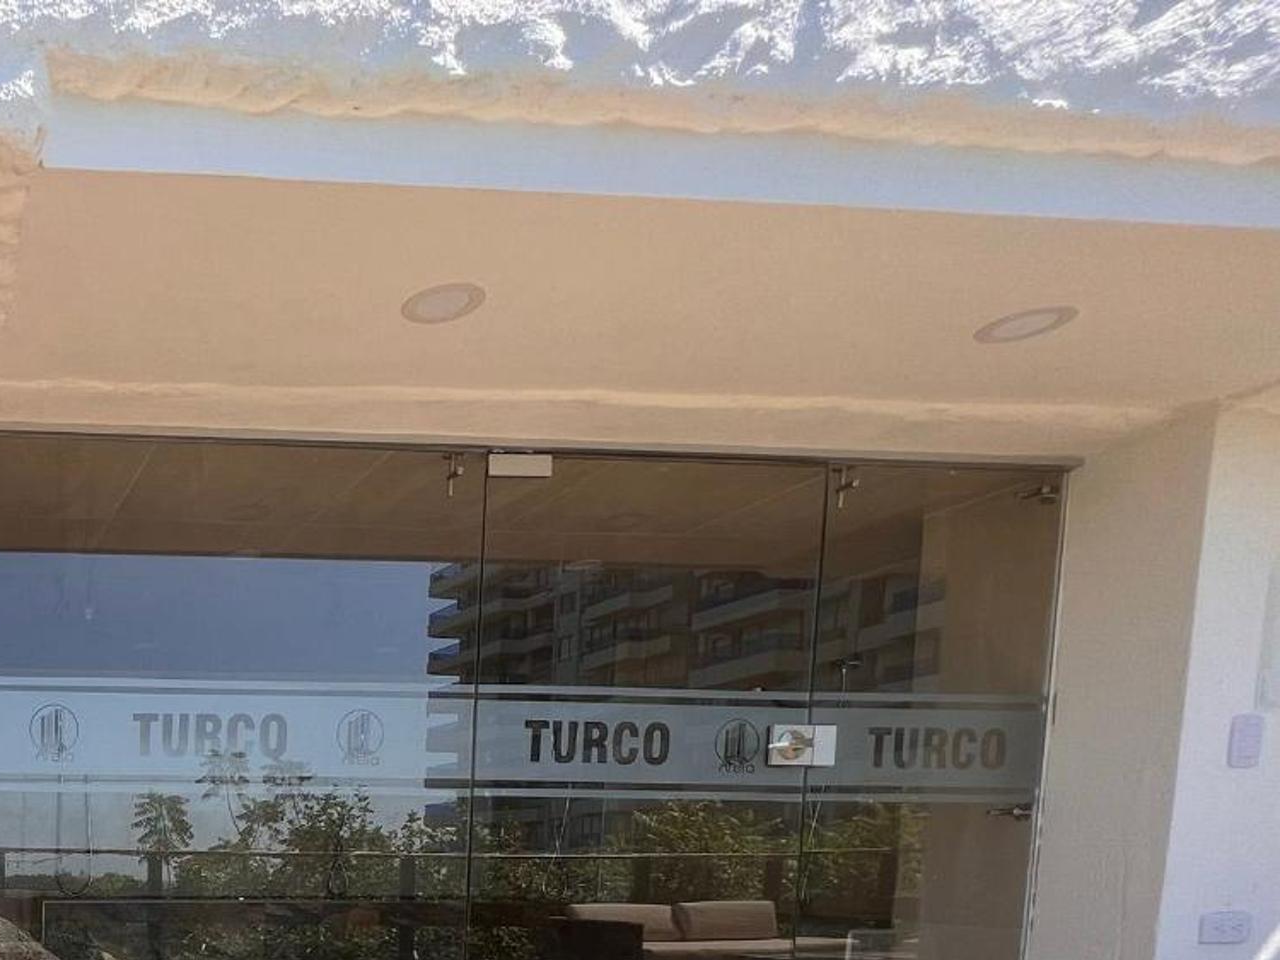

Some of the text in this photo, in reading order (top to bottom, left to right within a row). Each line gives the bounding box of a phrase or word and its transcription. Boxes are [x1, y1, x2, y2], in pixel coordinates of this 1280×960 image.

[133, 713, 287, 758] TURCO
[525, 720, 669, 765] TURCO
[869, 727, 1007, 769] TURCO
